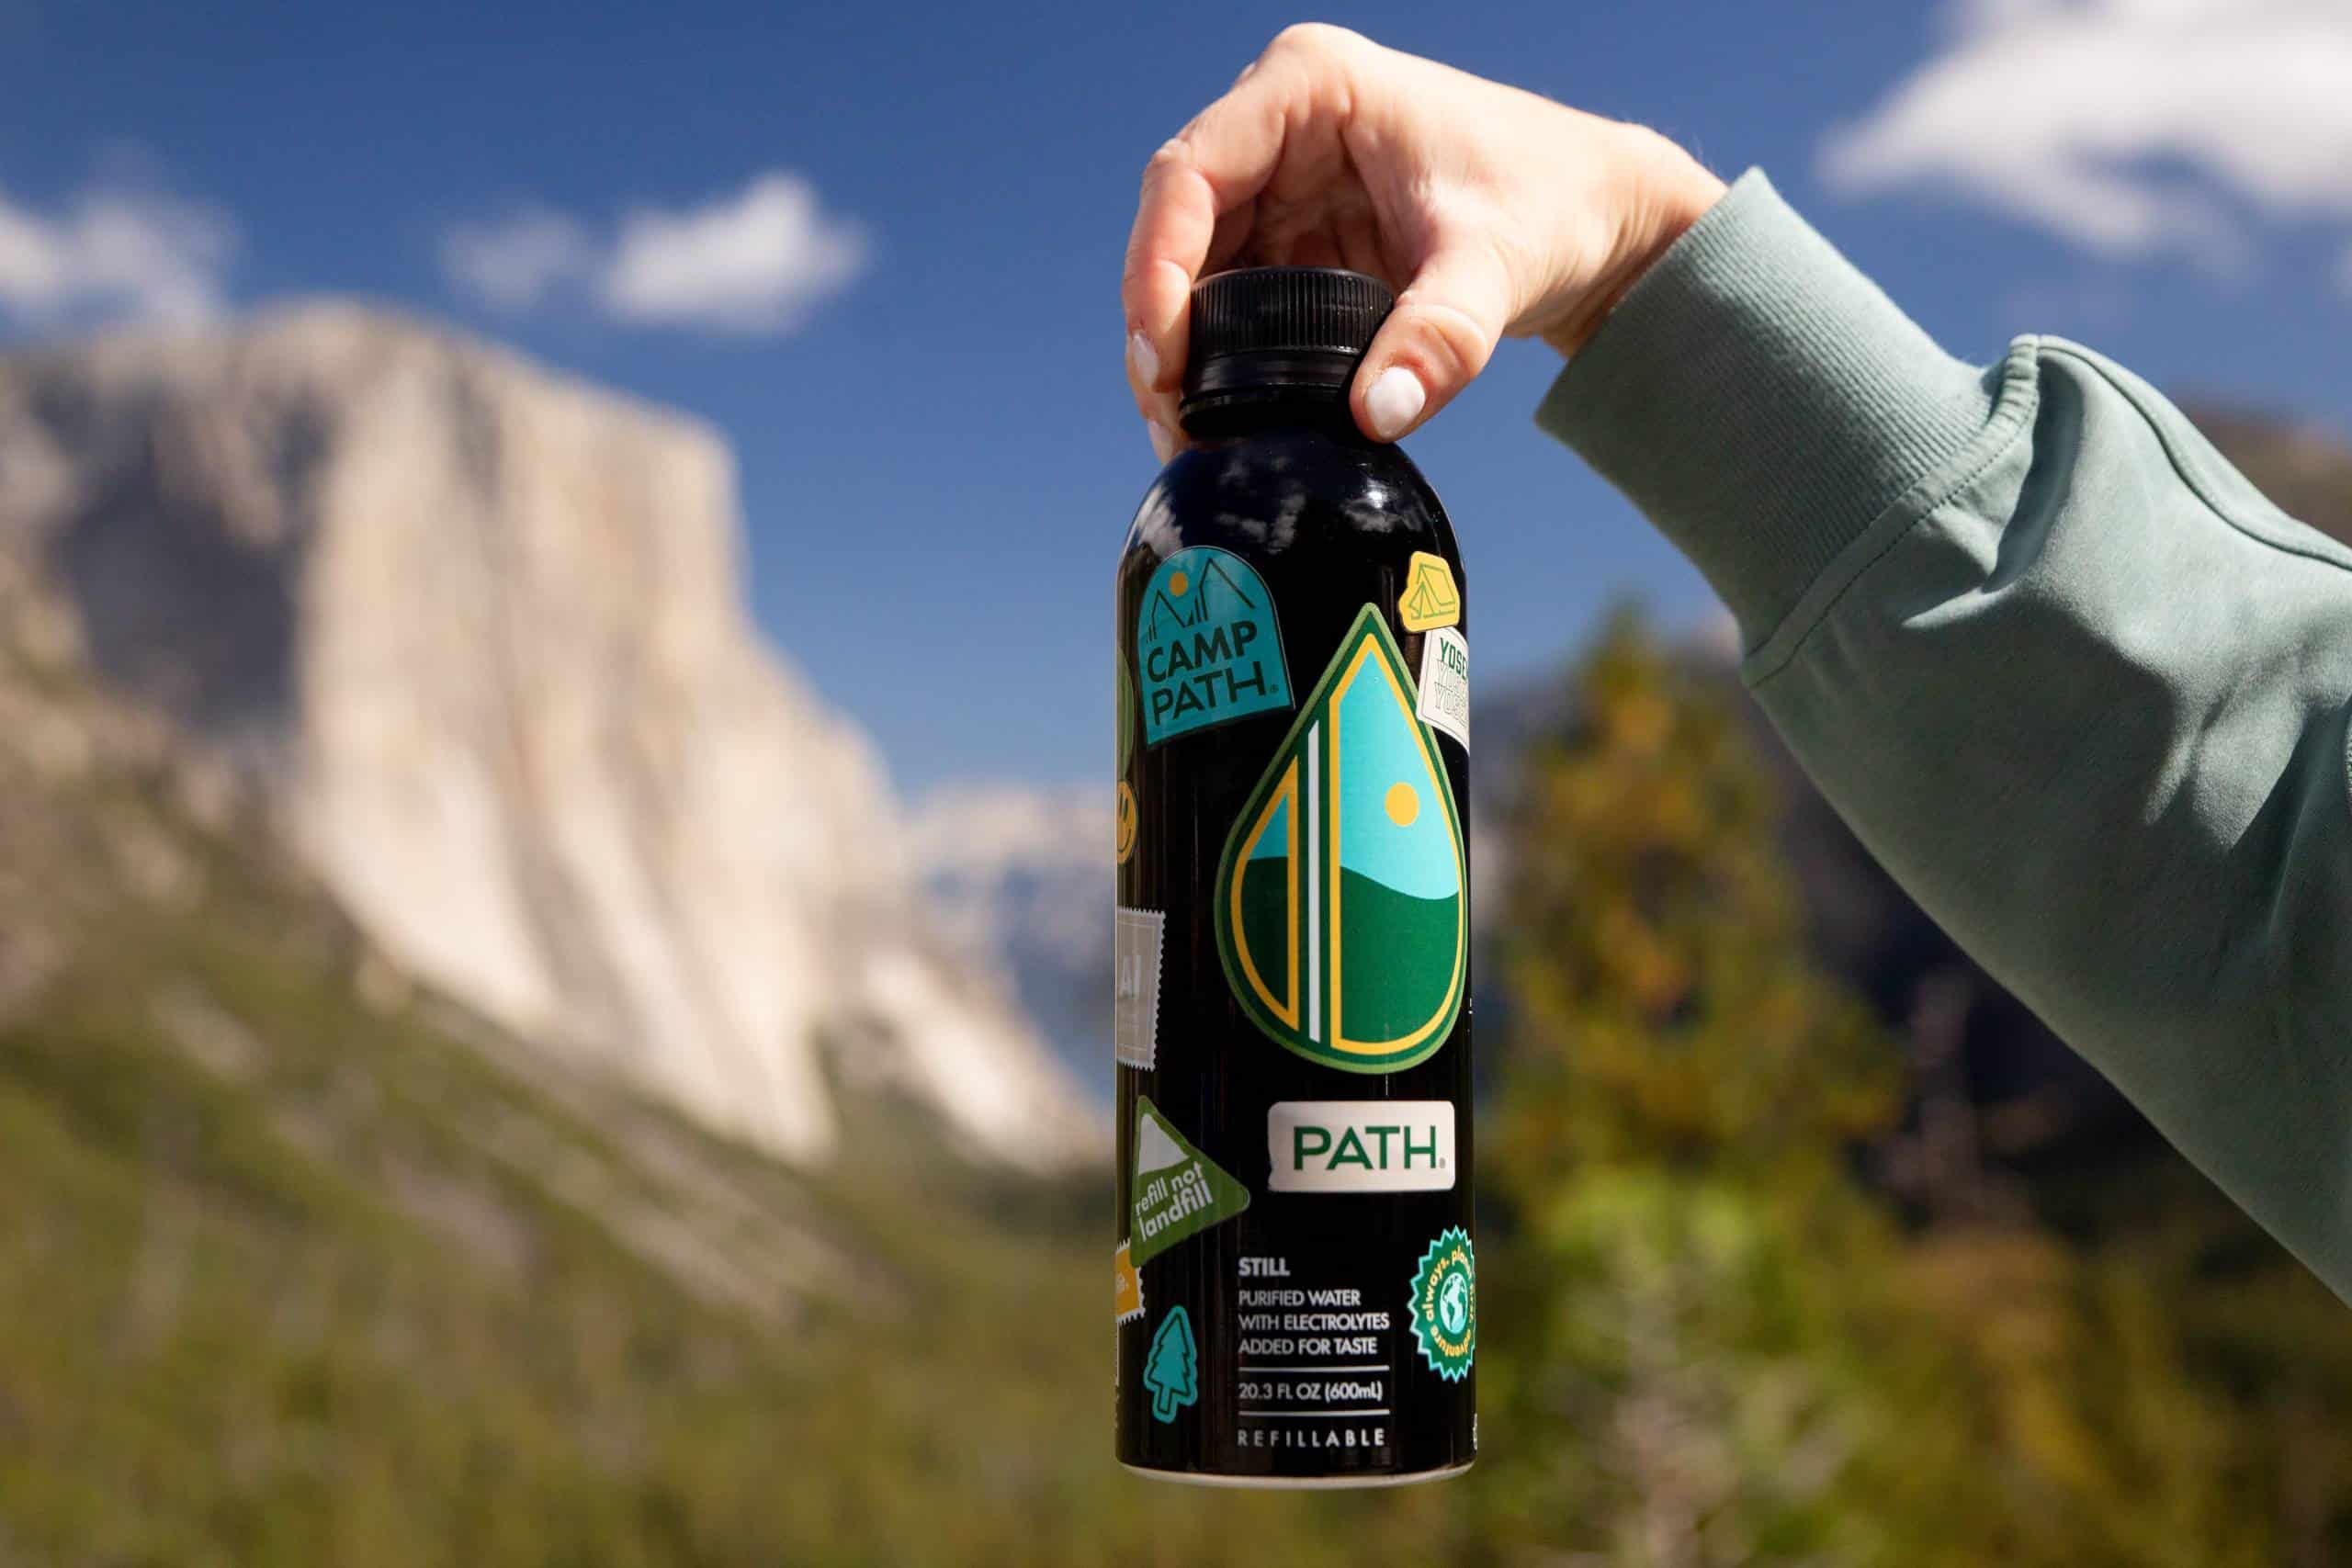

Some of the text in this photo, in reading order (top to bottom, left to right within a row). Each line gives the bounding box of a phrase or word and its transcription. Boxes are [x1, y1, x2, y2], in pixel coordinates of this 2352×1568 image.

[1147, 620, 1257, 682] CAMP
[1151, 660, 1265, 726] PATH
[1293, 1125, 1437, 1170] PATH
[1135, 1160, 1204, 1216] refill not
[1138, 1179, 1213, 1242] landfill
[1238, 1257, 1290, 1277] STILL
[1238, 1289, 1362, 1307] PURIFIED WATER
[1238, 1312, 1390, 1331] WITH ELECTROLYTES
[1238, 1337, 1378, 1355] ADDED FOR TASTE
[1238, 1381, 1384, 1404] 20.3 FL OZ (600mL)
[1238, 1427, 1385, 1448] REFILLABLE
